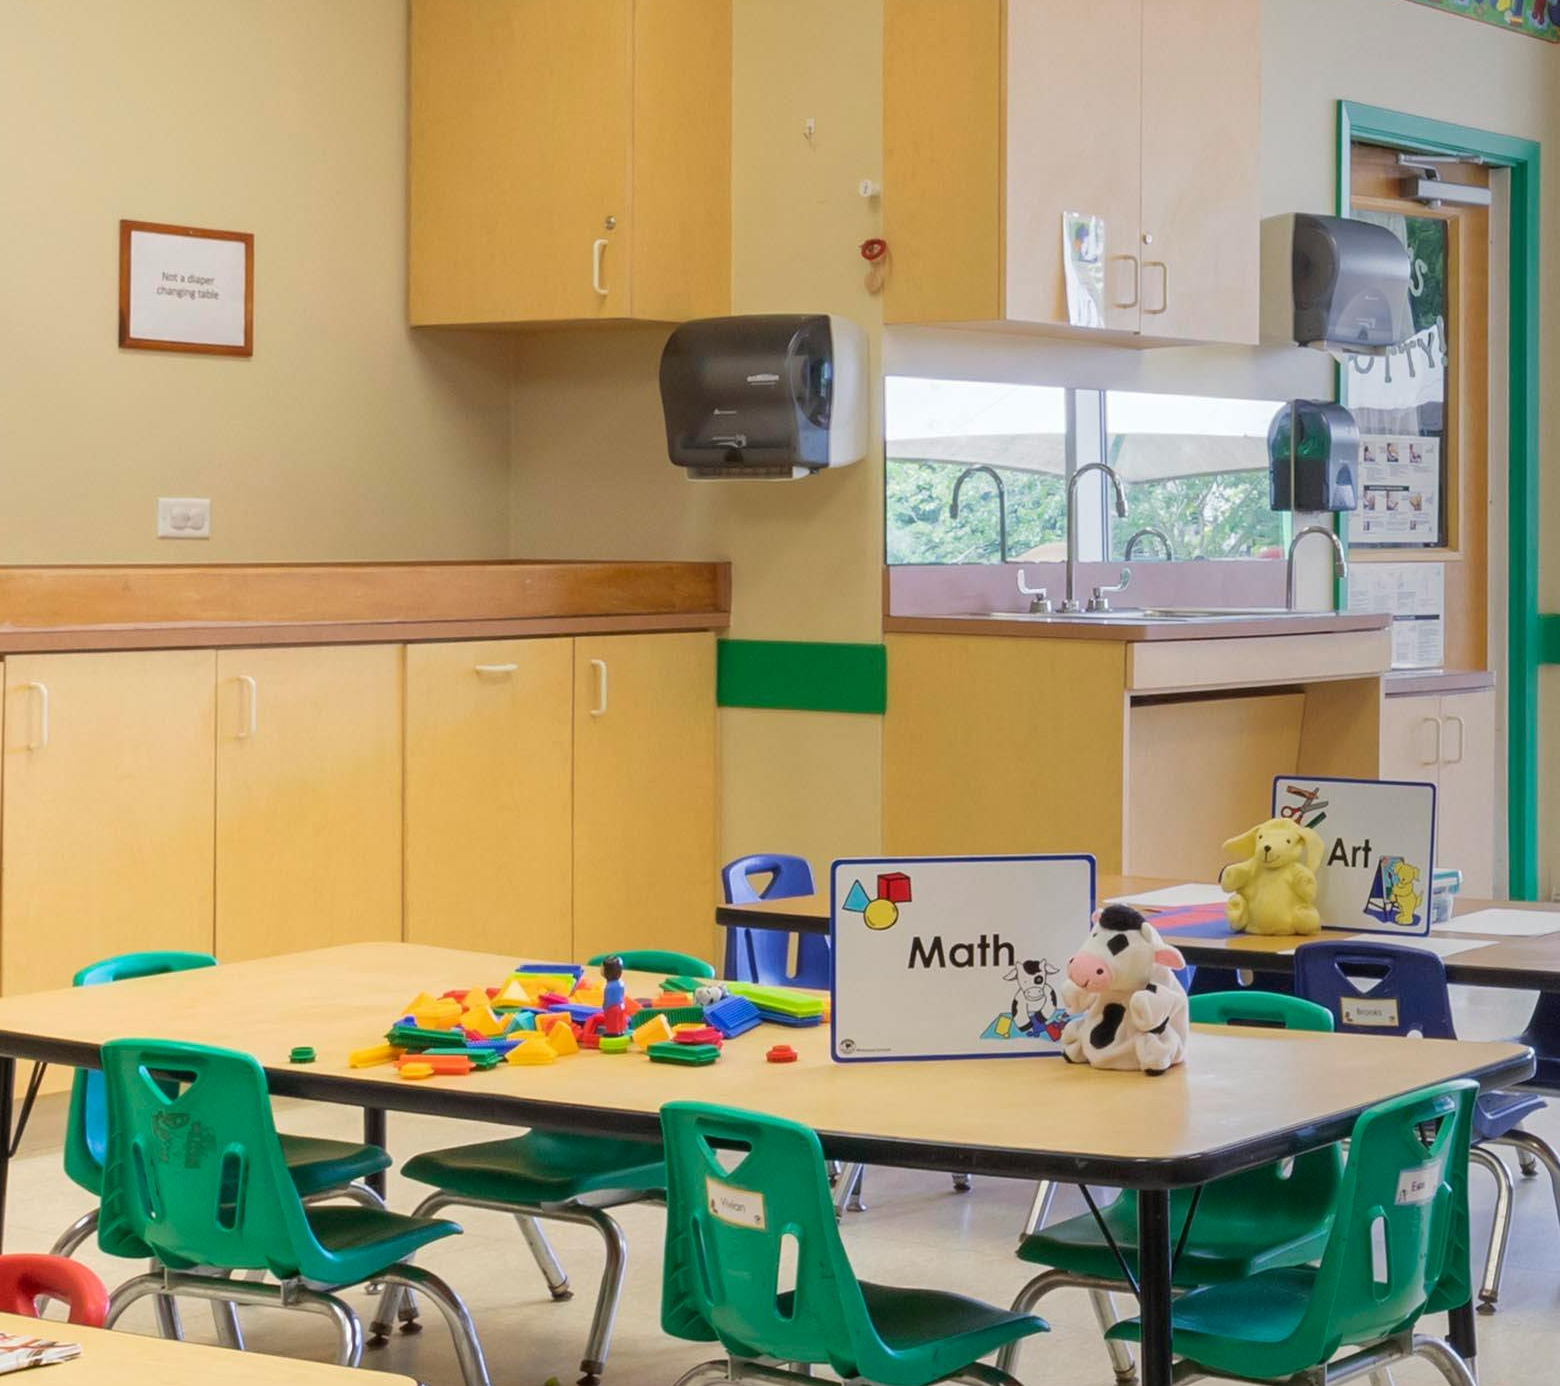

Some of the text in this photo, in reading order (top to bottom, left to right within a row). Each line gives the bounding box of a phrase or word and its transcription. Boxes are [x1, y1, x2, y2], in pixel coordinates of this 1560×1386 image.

[162, 271, 178, 282] Not
[187, 274, 215, 285] diaper
[1327, 838, 1372, 868] Art
[908, 934, 1015, 968] Math
